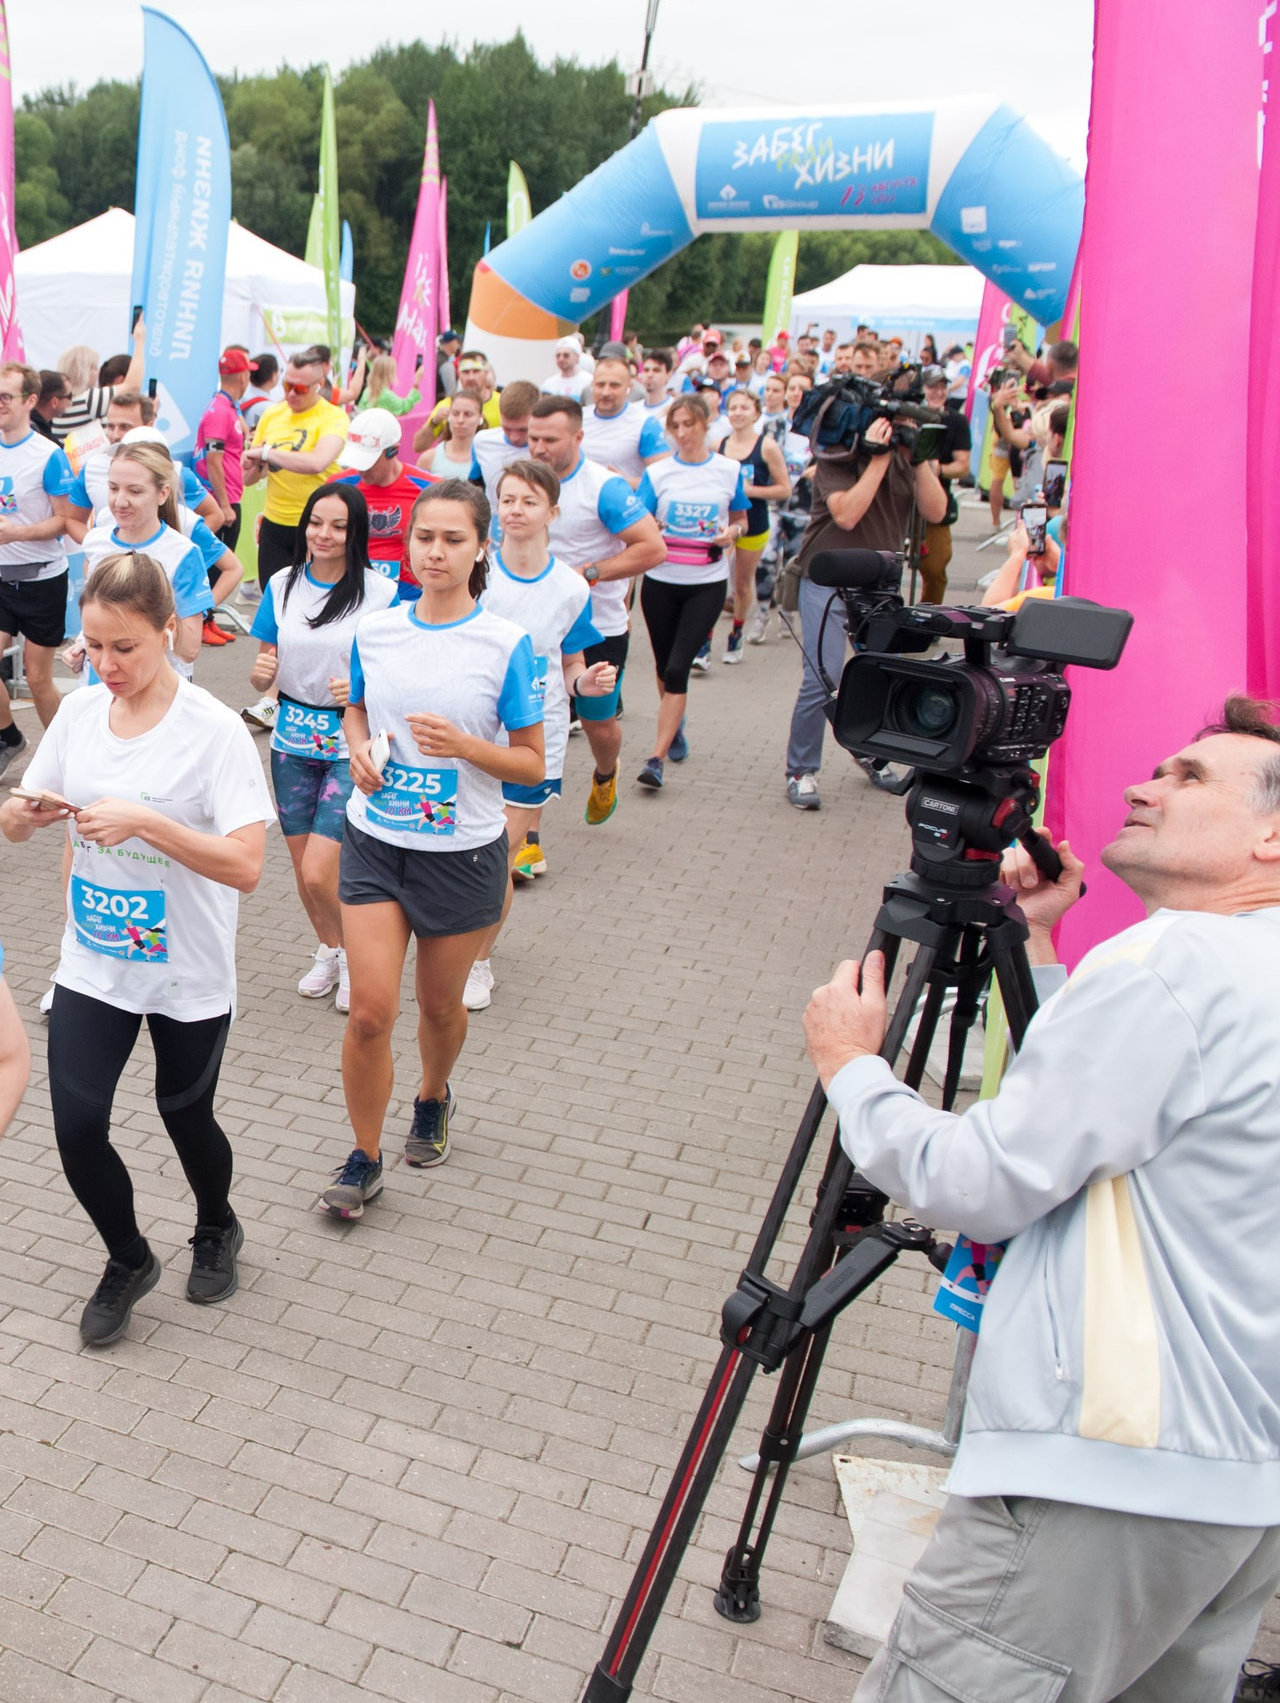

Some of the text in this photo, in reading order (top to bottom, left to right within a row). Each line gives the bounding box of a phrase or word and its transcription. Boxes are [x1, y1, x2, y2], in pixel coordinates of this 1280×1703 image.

[732, 122, 823, 170] ЗАБЕГ
[675, 503, 712, 518] 3327
[285, 704, 330, 731] 3245
[382, 765, 441, 794] 3225
[924, 799, 956, 813] CARTONI
[98, 845, 112, 855] ЗА
[117, 848, 171, 868] БУДУЩЕЕ
[81, 884, 149, 920] 3202
